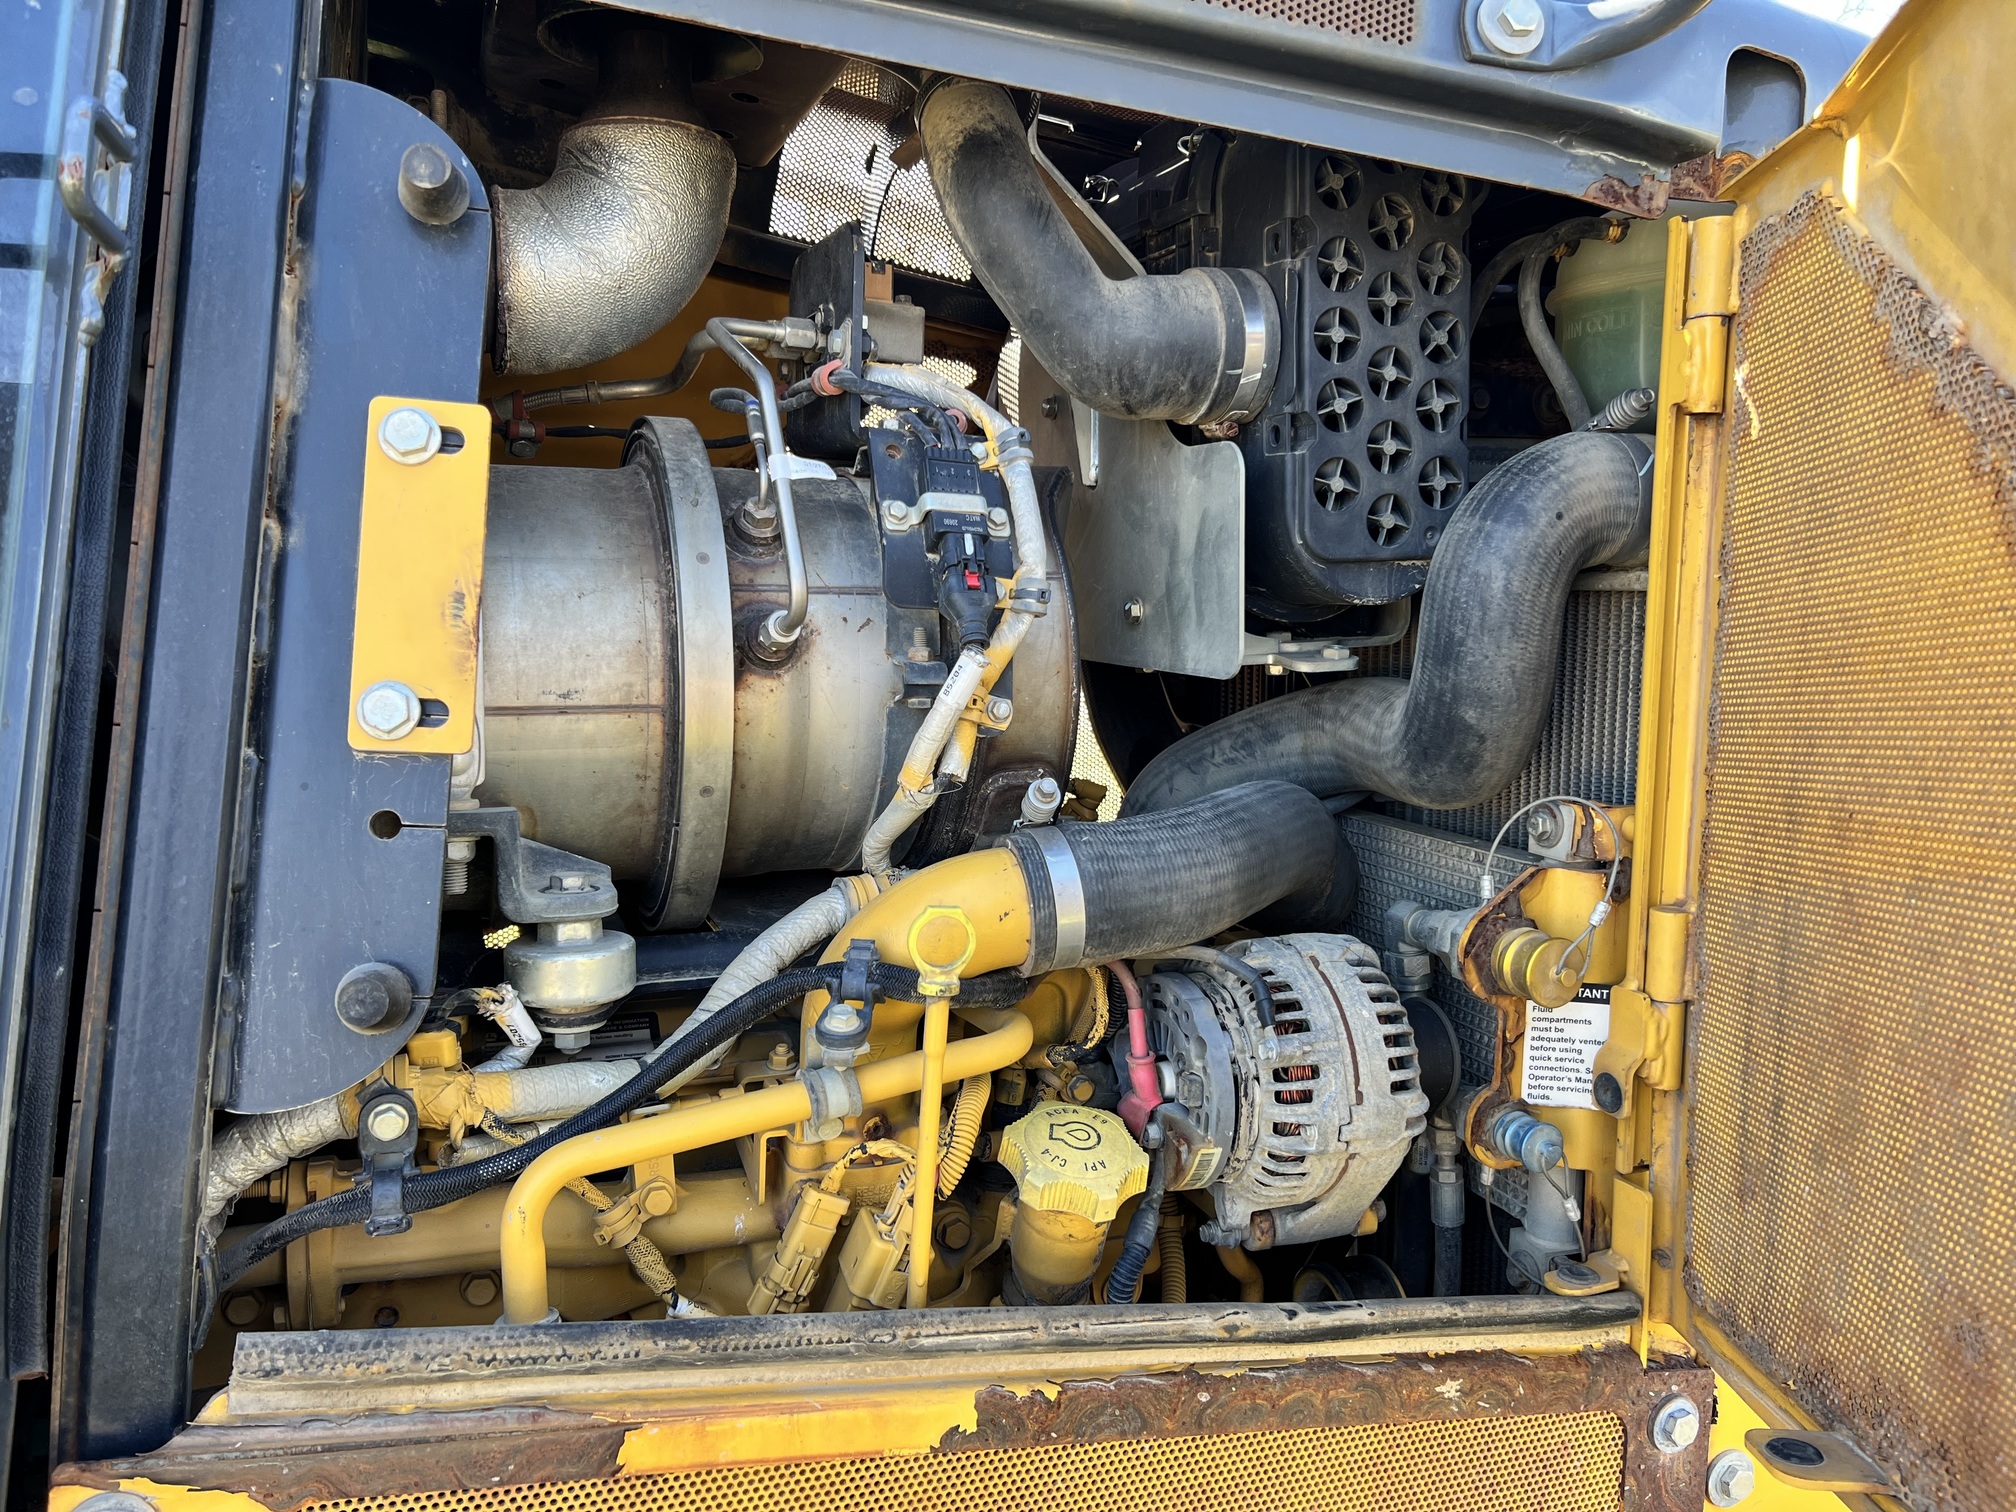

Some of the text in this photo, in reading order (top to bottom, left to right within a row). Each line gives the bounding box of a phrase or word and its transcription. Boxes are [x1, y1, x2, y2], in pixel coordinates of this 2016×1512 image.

[1531, 1016, 1593, 1026] compartments
[1554, 1026, 1565, 1034] be
[1530, 1035, 1577, 1046] adequately
[1529, 1044, 1583, 1056] before using
[1529, 1055, 1585, 1065] quick service
[1528, 1064, 1583, 1075] connections.
[1528, 1073, 1572, 1083] Operator's
[1527, 1083, 1555, 1091] before
[1527, 1092, 1553, 1101] fluids.
[1045, 1108, 1108, 1125] ACEA E9
[1040, 1148, 1107, 1172] API CJ-4
